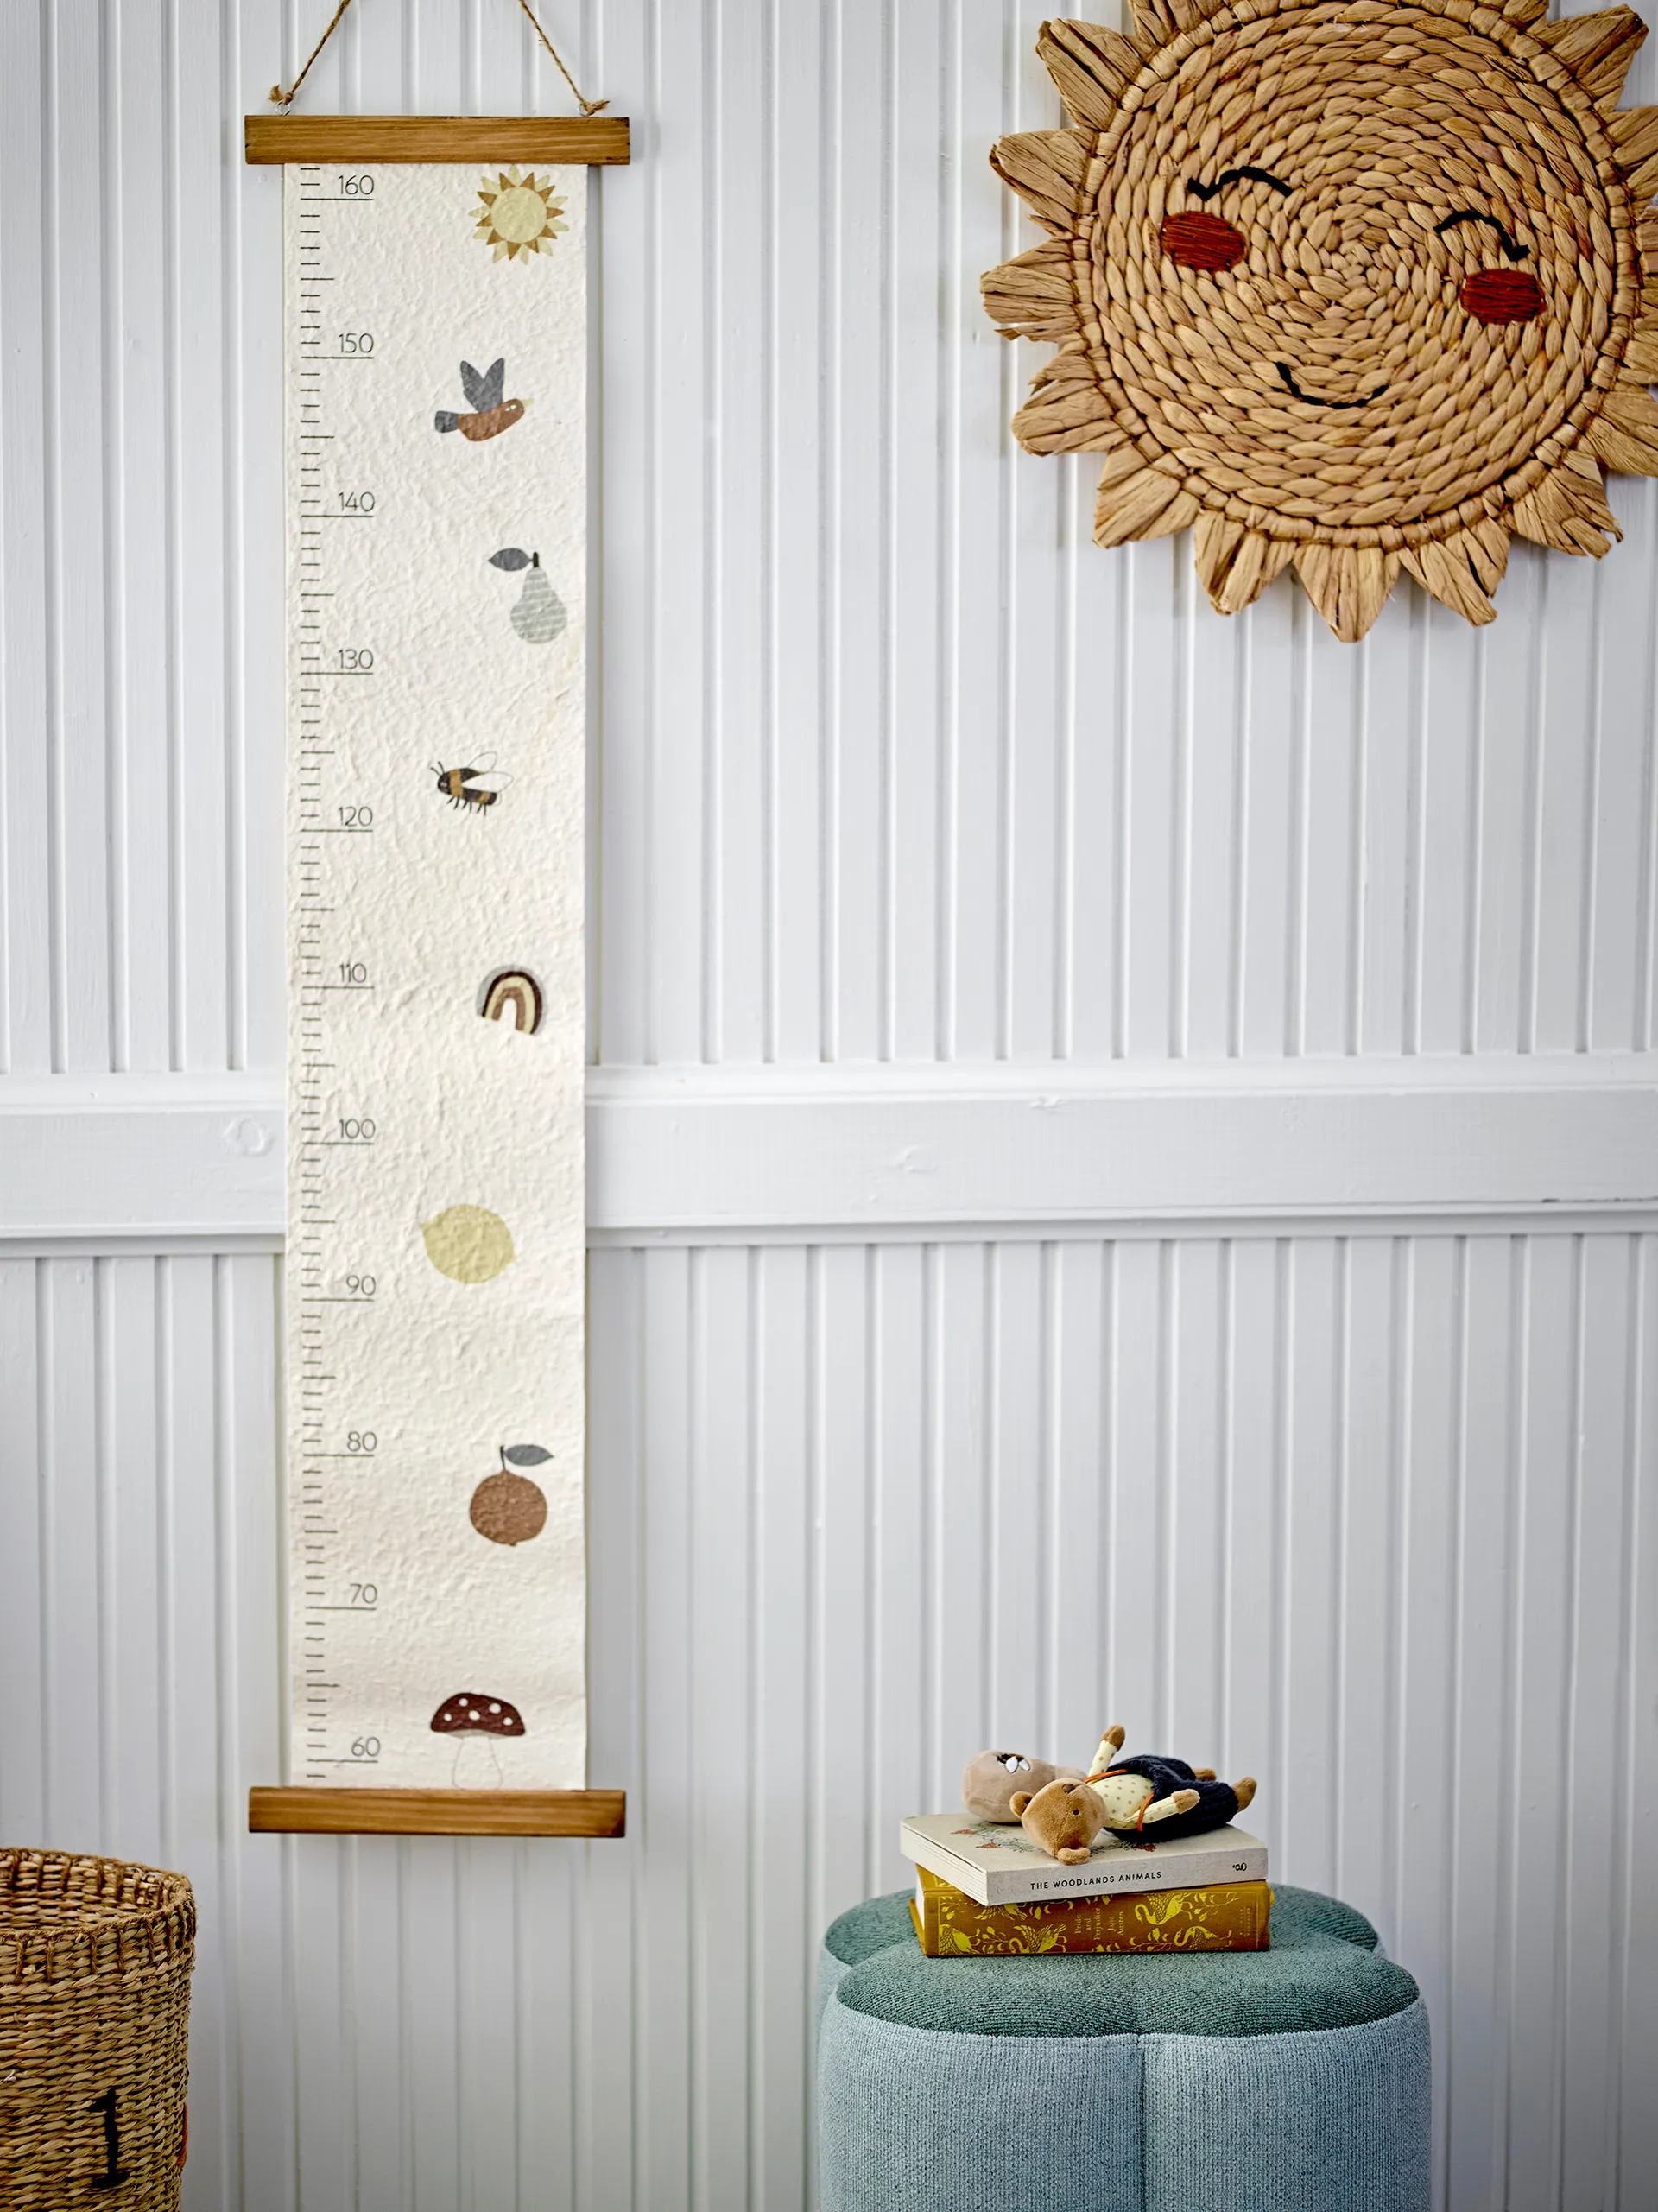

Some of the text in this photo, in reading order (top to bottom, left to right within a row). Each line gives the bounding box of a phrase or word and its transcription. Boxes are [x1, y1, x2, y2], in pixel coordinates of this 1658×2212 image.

[338, 174, 375, 196] 160
[338, 333, 375, 354] 150
[338, 491, 376, 513] 140
[338, 649, 374, 670] 130
[338, 806, 373, 827] 120
[339, 963, 367, 984] 110
[339, 1119, 376, 1139] 100
[345, 1275, 377, 1296] 90
[346, 1431, 377, 1453] 80
[350, 1583, 377, 1605] 70
[351, 1736, 381, 1758] 60
[1030, 1871, 1162, 1890] THE WOODLANDS ANIMALS
[1093, 1907, 1103, 1940] Prejudice
